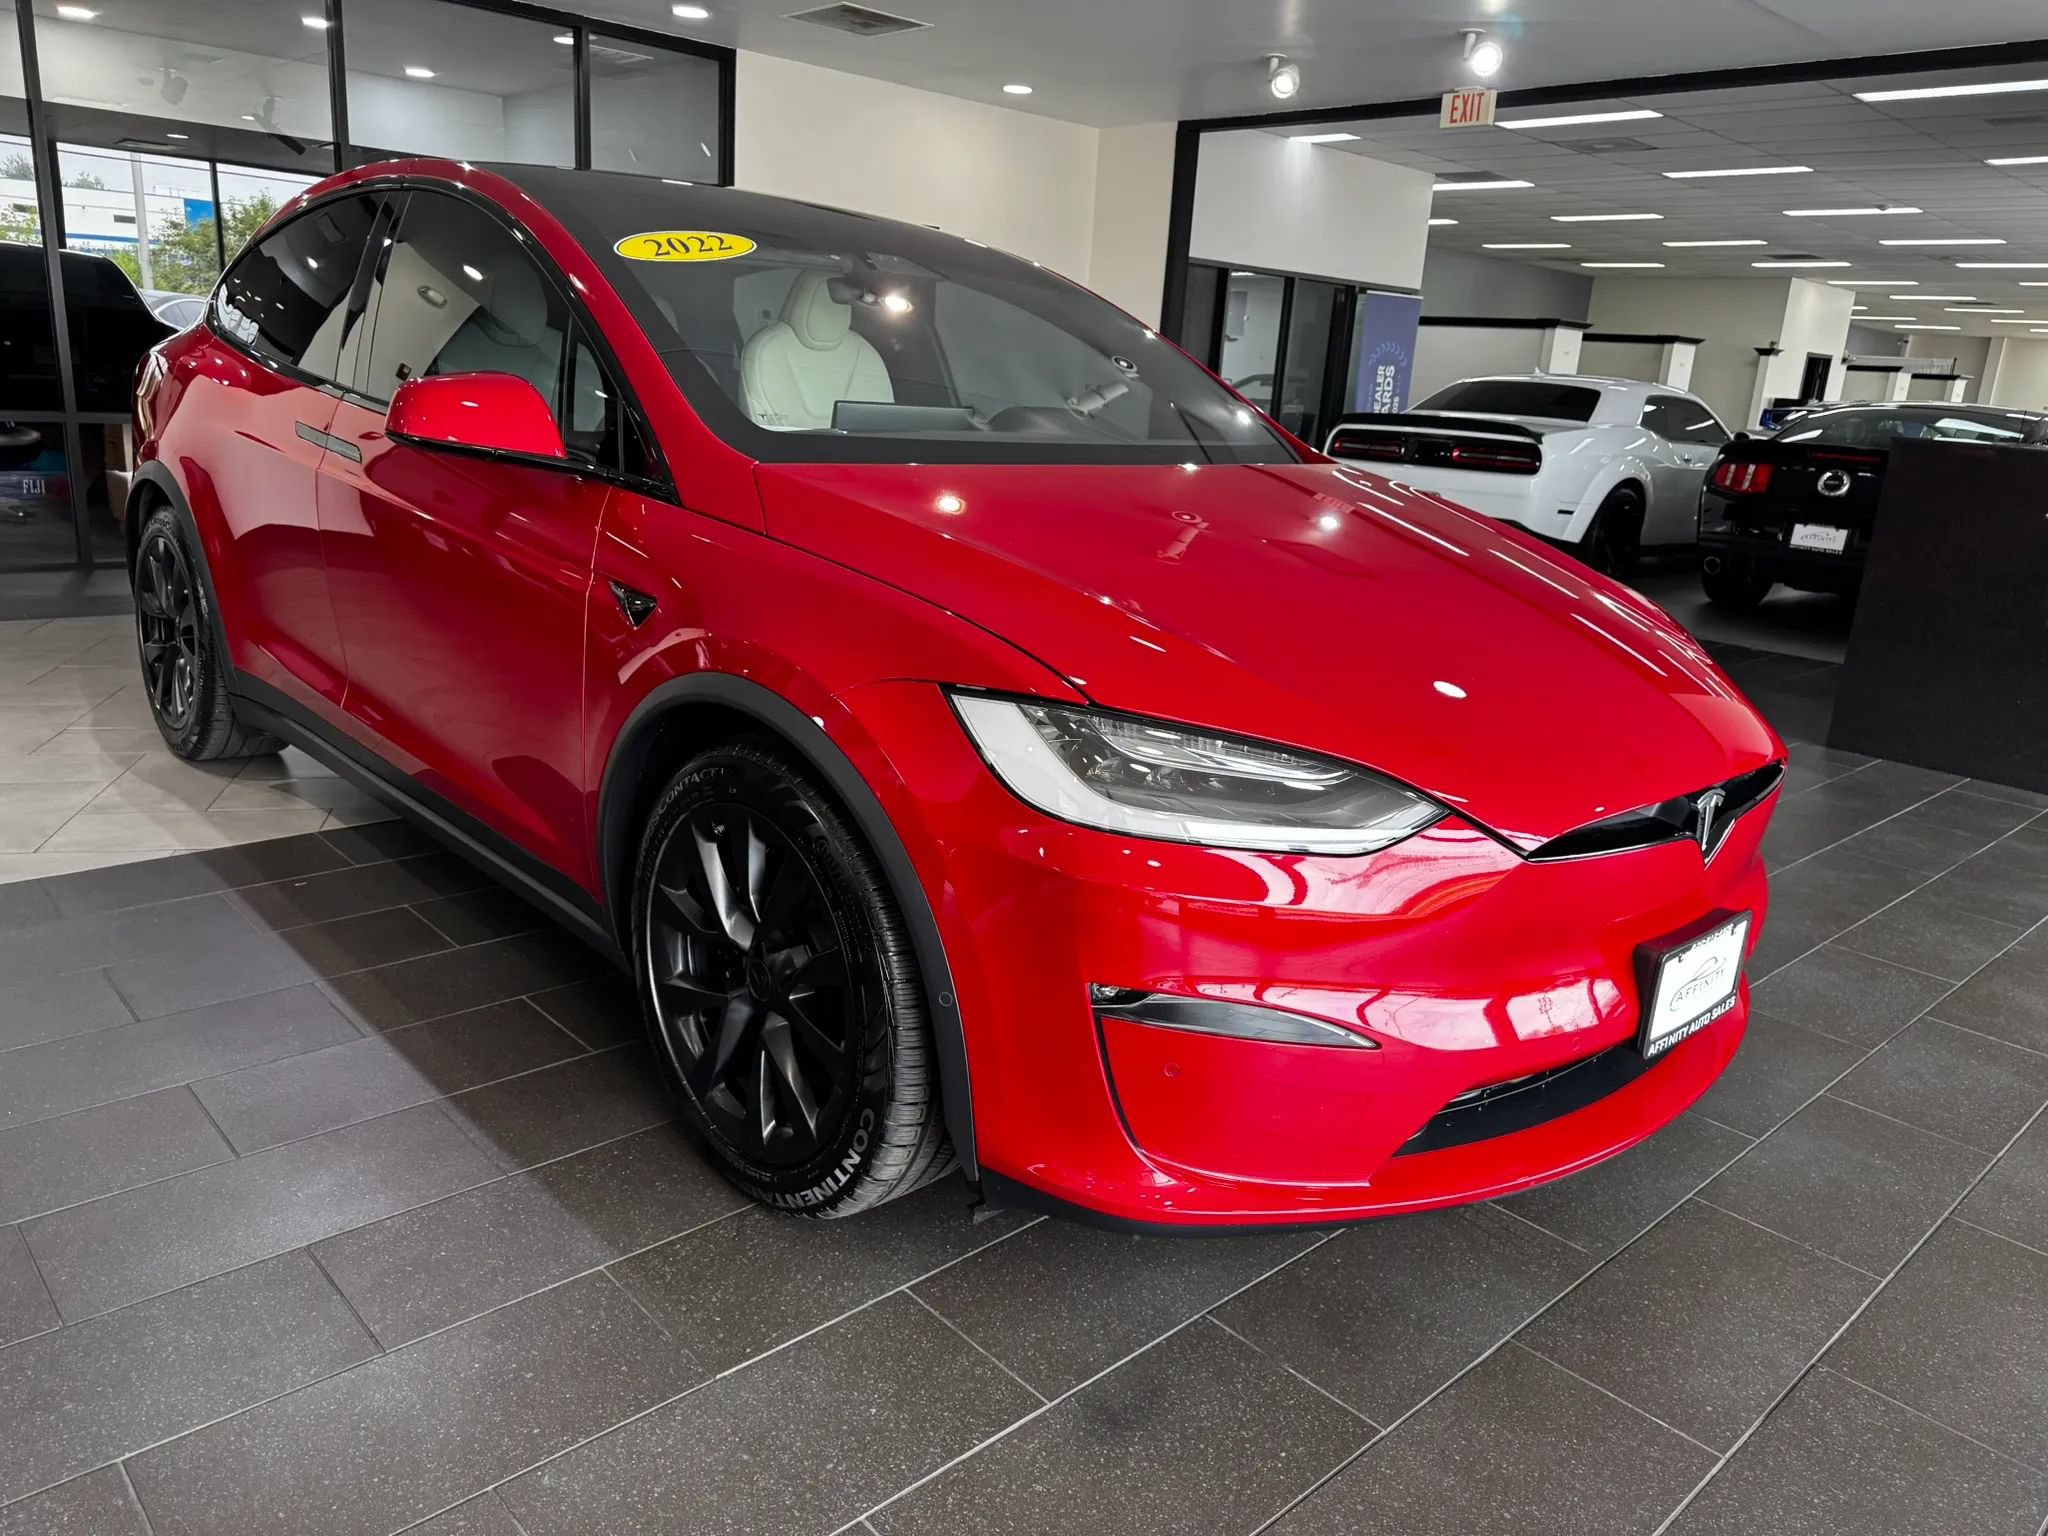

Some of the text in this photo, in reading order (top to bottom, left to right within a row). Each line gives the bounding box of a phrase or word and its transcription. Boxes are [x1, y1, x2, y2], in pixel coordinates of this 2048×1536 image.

[1449, 92, 1485, 124] EXIT
[643, 234, 733, 257] 2022
[1373, 365, 1386, 413] EALER
[22, 479, 47, 496] FIJI
[1675, 968, 1726, 1002] AFFINITY
[1648, 996, 1736, 1057] AFFINITY AUTO SALES
